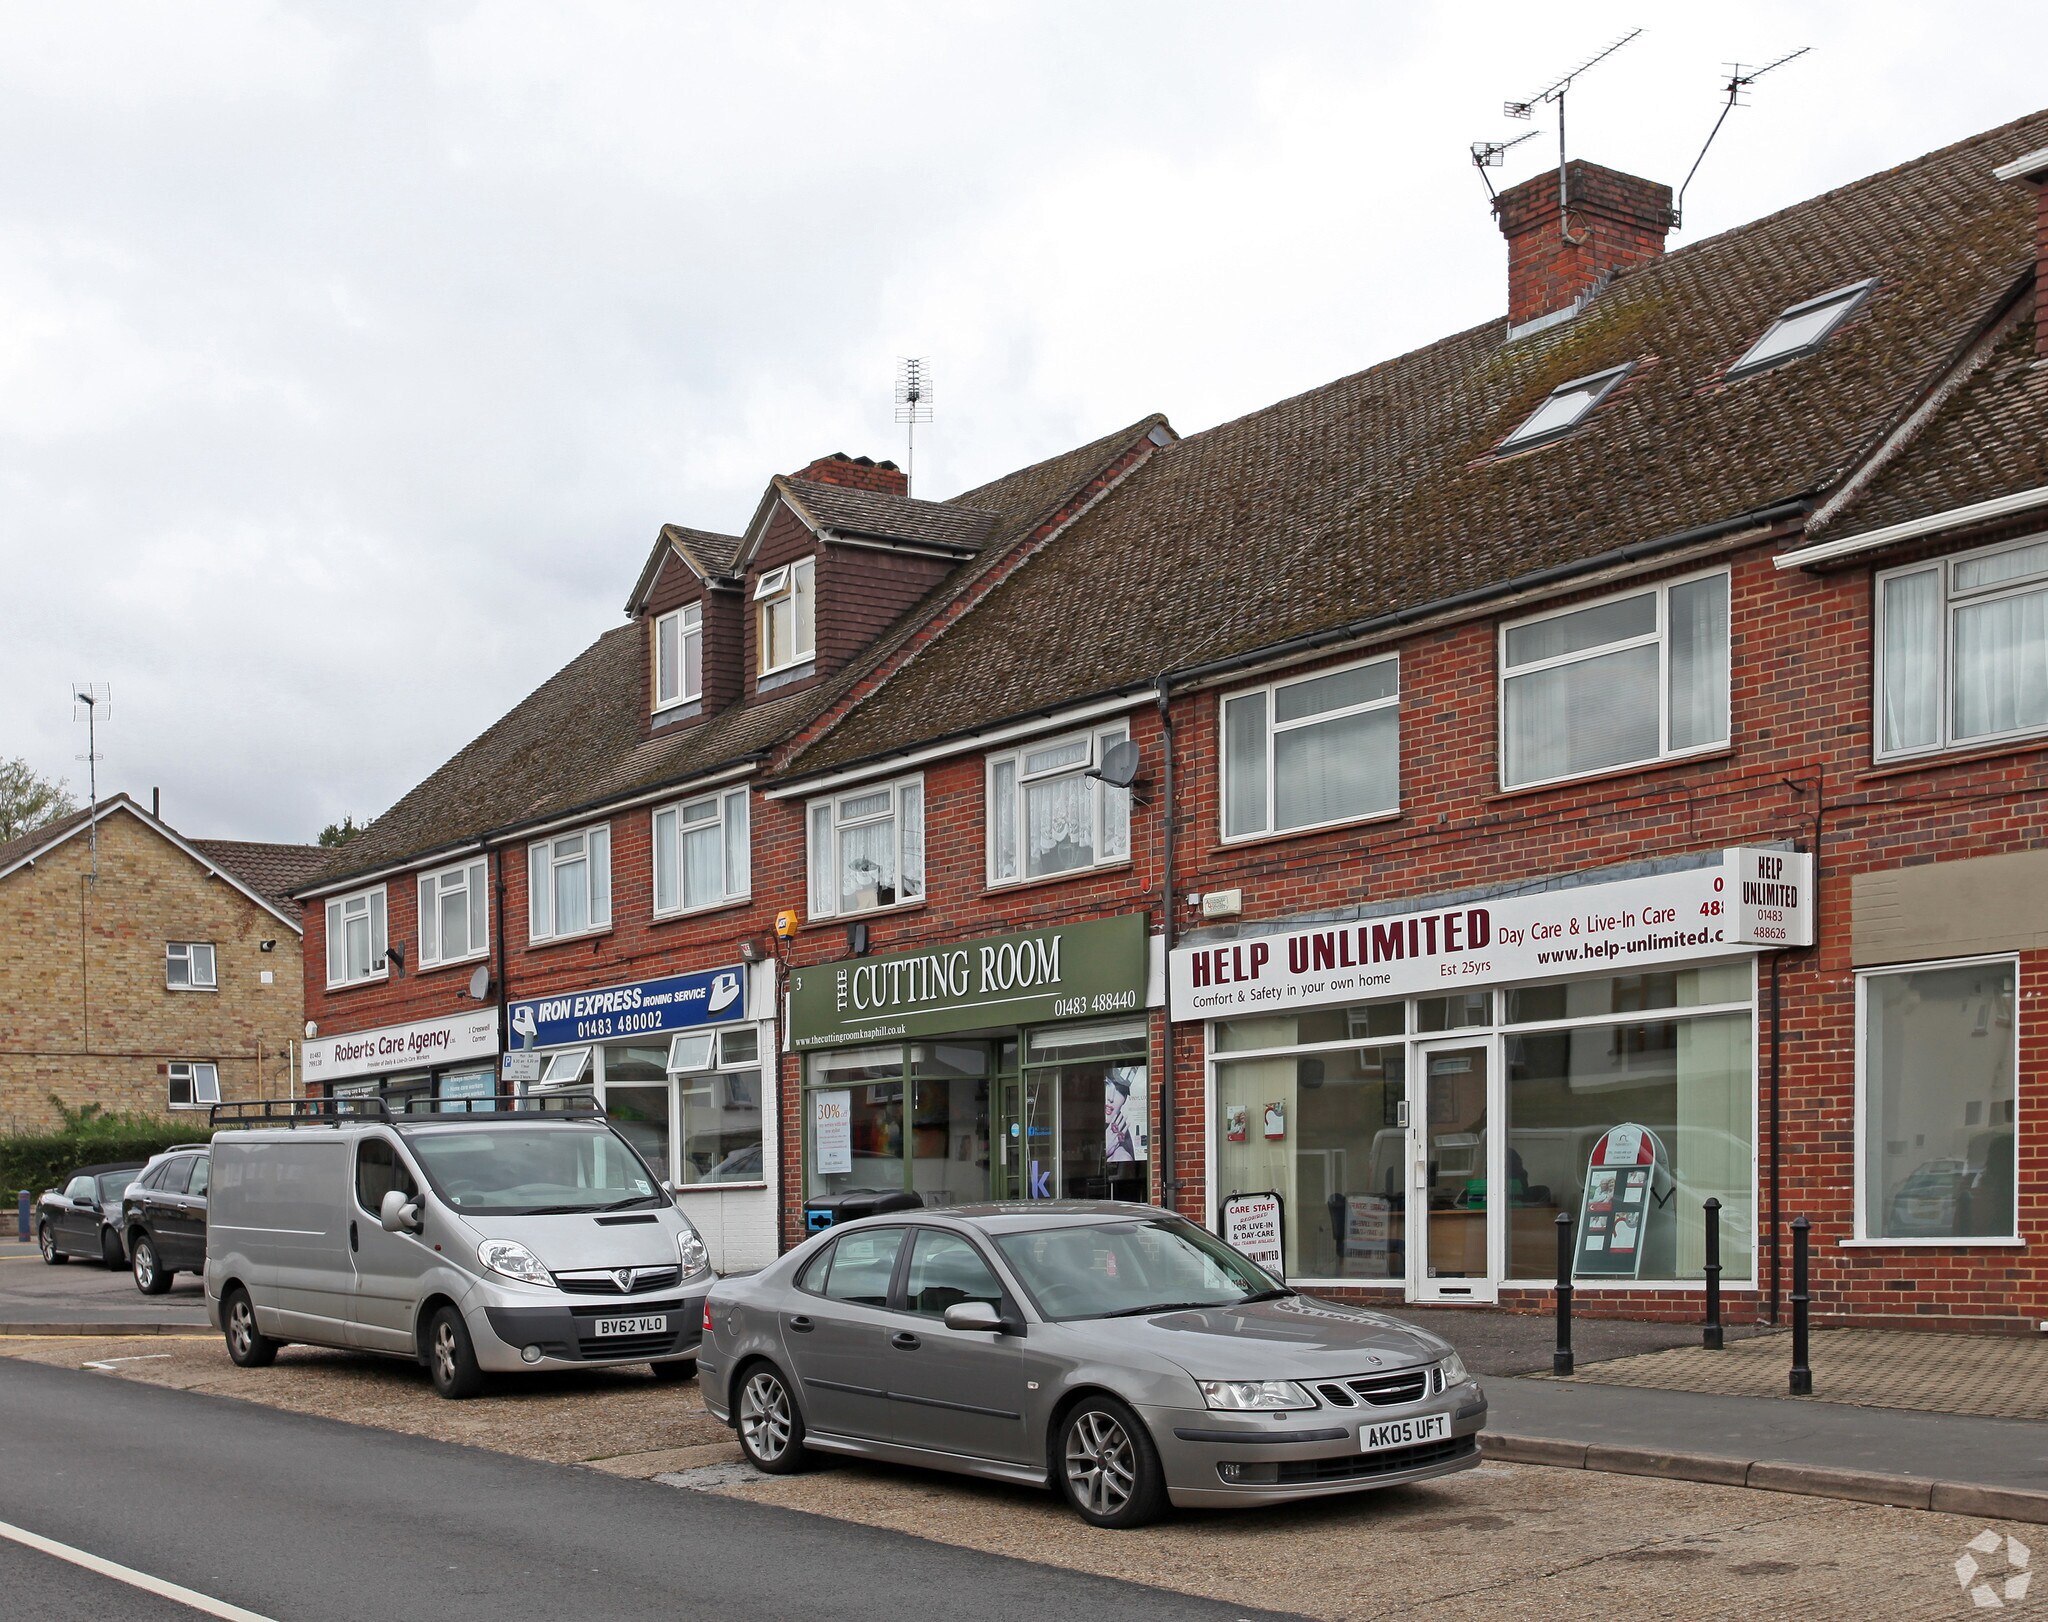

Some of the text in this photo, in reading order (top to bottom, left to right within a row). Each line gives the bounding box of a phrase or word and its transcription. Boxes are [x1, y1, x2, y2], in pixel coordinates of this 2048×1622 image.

[1758, 855, 1783, 880] HELP
[1742, 881, 1798, 908] UNLIMITED
[1499, 906, 1676, 947] Day Care & Live-In Care
[1757, 909, 1783, 922] 01483
[1537, 927, 1724, 964] www.help-unlimited.c
[1753, 926, 1786, 939] 488626
[1191, 908, 1492, 988] HELP UNLIMITED
[837, 935, 1062, 1012] THE CUTTING ROOM
[1440, 960, 1492, 978] Est 25yrs
[796, 977, 802, 991] 3
[1192, 973, 1391, 1008] Comfort & Safety in your own home
[538, 987, 707, 1023] IRON EXPRESS IRONING SERVICE
[1054, 989, 1136, 1017] 01483 488440
[578, 1010, 662, 1038] 01483 480002
[795, 1024, 906, 1047] www.thecuttingroomknaphill.co.uk
[334, 1040, 375, 1062] Roberts
[378, 1036, 405, 1055] Care
[408, 1029, 451, 1054] Agency
[472, 1035, 487, 1043] Corner
[818, 1103, 840, 1120] 30%
[1032, 1160, 1051, 1199] k
[1229, 1203, 1275, 1214] CARE STAFF
[1233, 1221, 1274, 1231] FOR LIVE-IN
[1241, 1230, 1275, 1239] DAY-CARE
[601, 1318, 662, 1334] BV62 VLO
[1369, 1417, 1444, 1447] AK05 UFT
